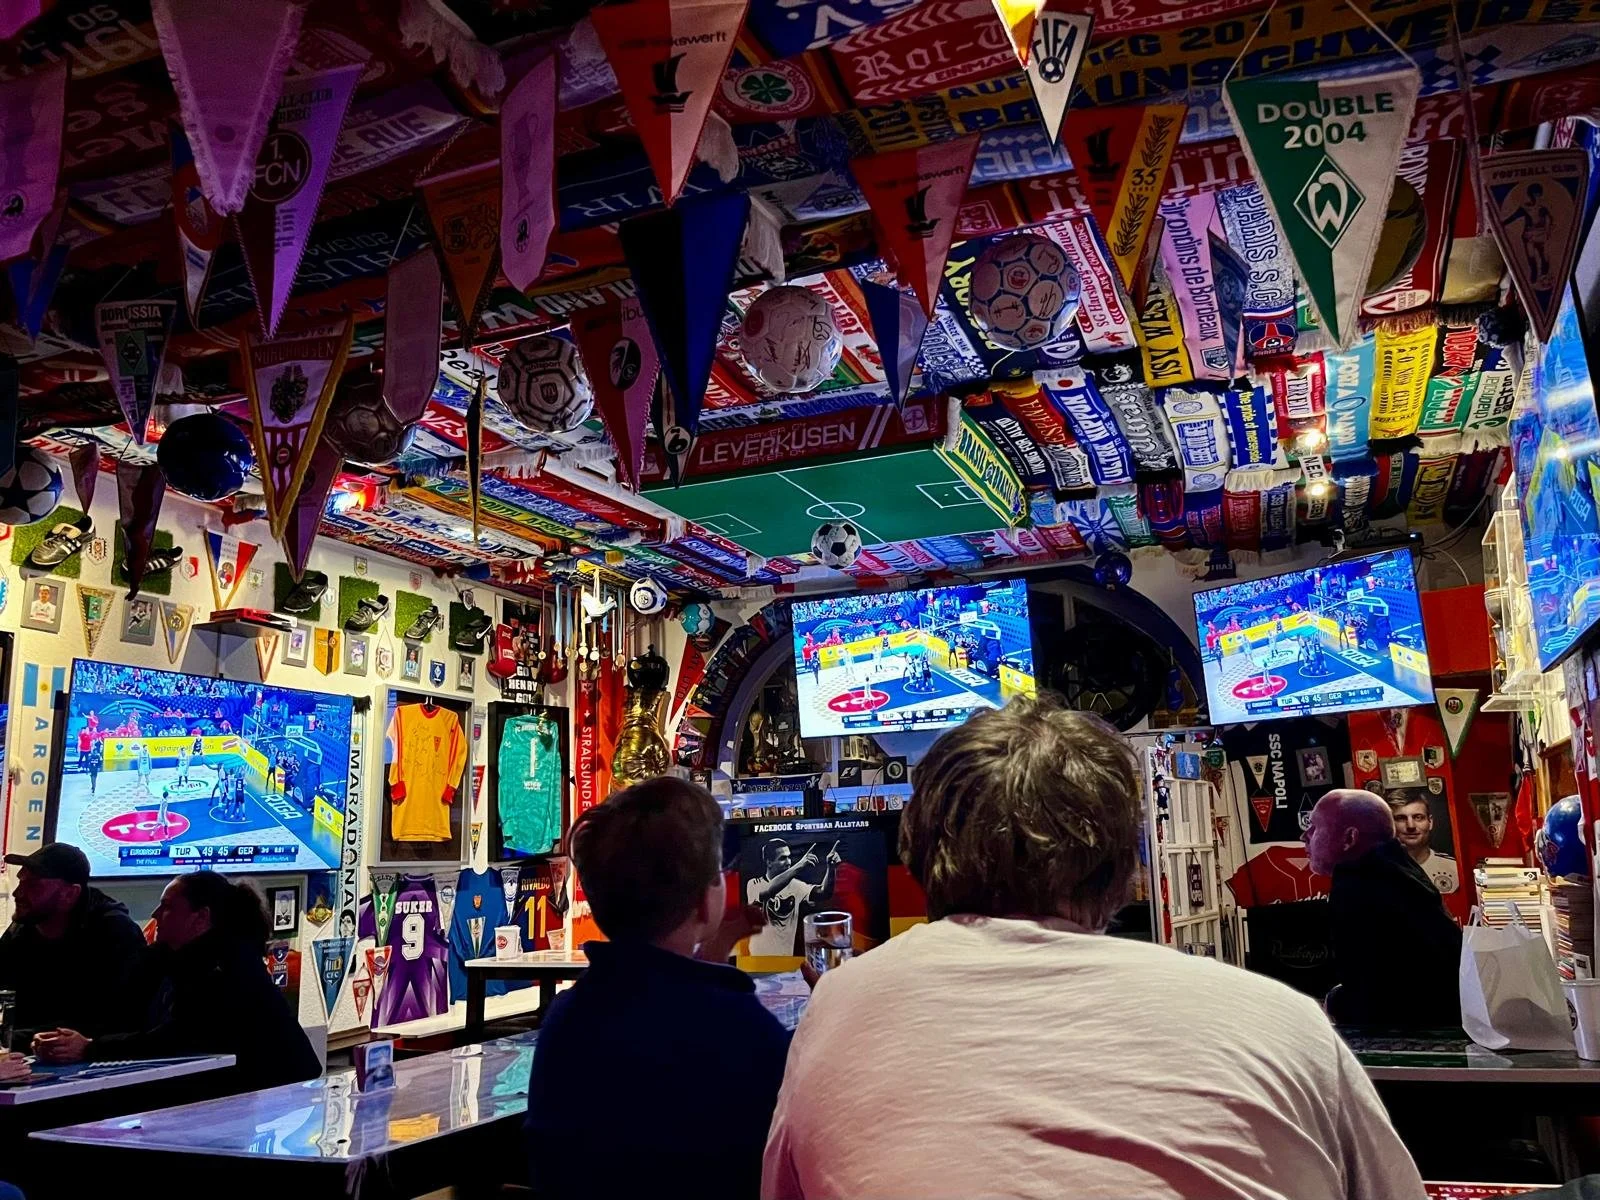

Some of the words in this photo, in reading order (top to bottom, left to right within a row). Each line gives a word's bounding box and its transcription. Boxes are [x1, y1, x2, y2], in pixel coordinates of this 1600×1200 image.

[1033, 15, 1078, 62] FIFA
[1180, 7, 1304, 52] 2011
[1257, 92, 1395, 124] DOUBLE
[1283, 120, 1367, 149] 2004
[1131, 168, 1160, 185] 35
[1235, 193, 1279, 261] PARIS
[1180, 267, 1202, 284] de
[1188, 283, 1220, 341] Bordeaux
[1150, 347, 1183, 380] TSV
[1060, 393, 1109, 444] NIPPON
[959, 426, 987, 475] BRASIL
[1016, 430, 1031, 449] FOR
[1246, 430, 1261, 464] merseyside
[1023, 446, 1046, 476] VIKING
[1098, 440, 1124, 480] ULTRA
[1569, 487, 1592, 523] RIGA
[508, 678, 538, 692] HENRY
[1312, 694, 1322, 703] 45
[1328, 692, 1342, 701] GER
[1268, 733, 1282, 761] SSC
[1270, 758, 1289, 810] NAPOLI
[260, 793, 304, 821] RIGA
[754, 822, 793, 832] FACEBOOK
[834, 819, 870, 829] ALLSTARS
[175, 847, 192, 856] TUR
[202, 846, 213, 857] 49
[217, 846, 229, 857] 45
[238, 846, 254, 856] GER
[521, 875, 551, 890] RIVALDO
[394, 899, 433, 915] SUKER
[525, 895, 548, 941] 11
[401, 913, 426, 961] 9
